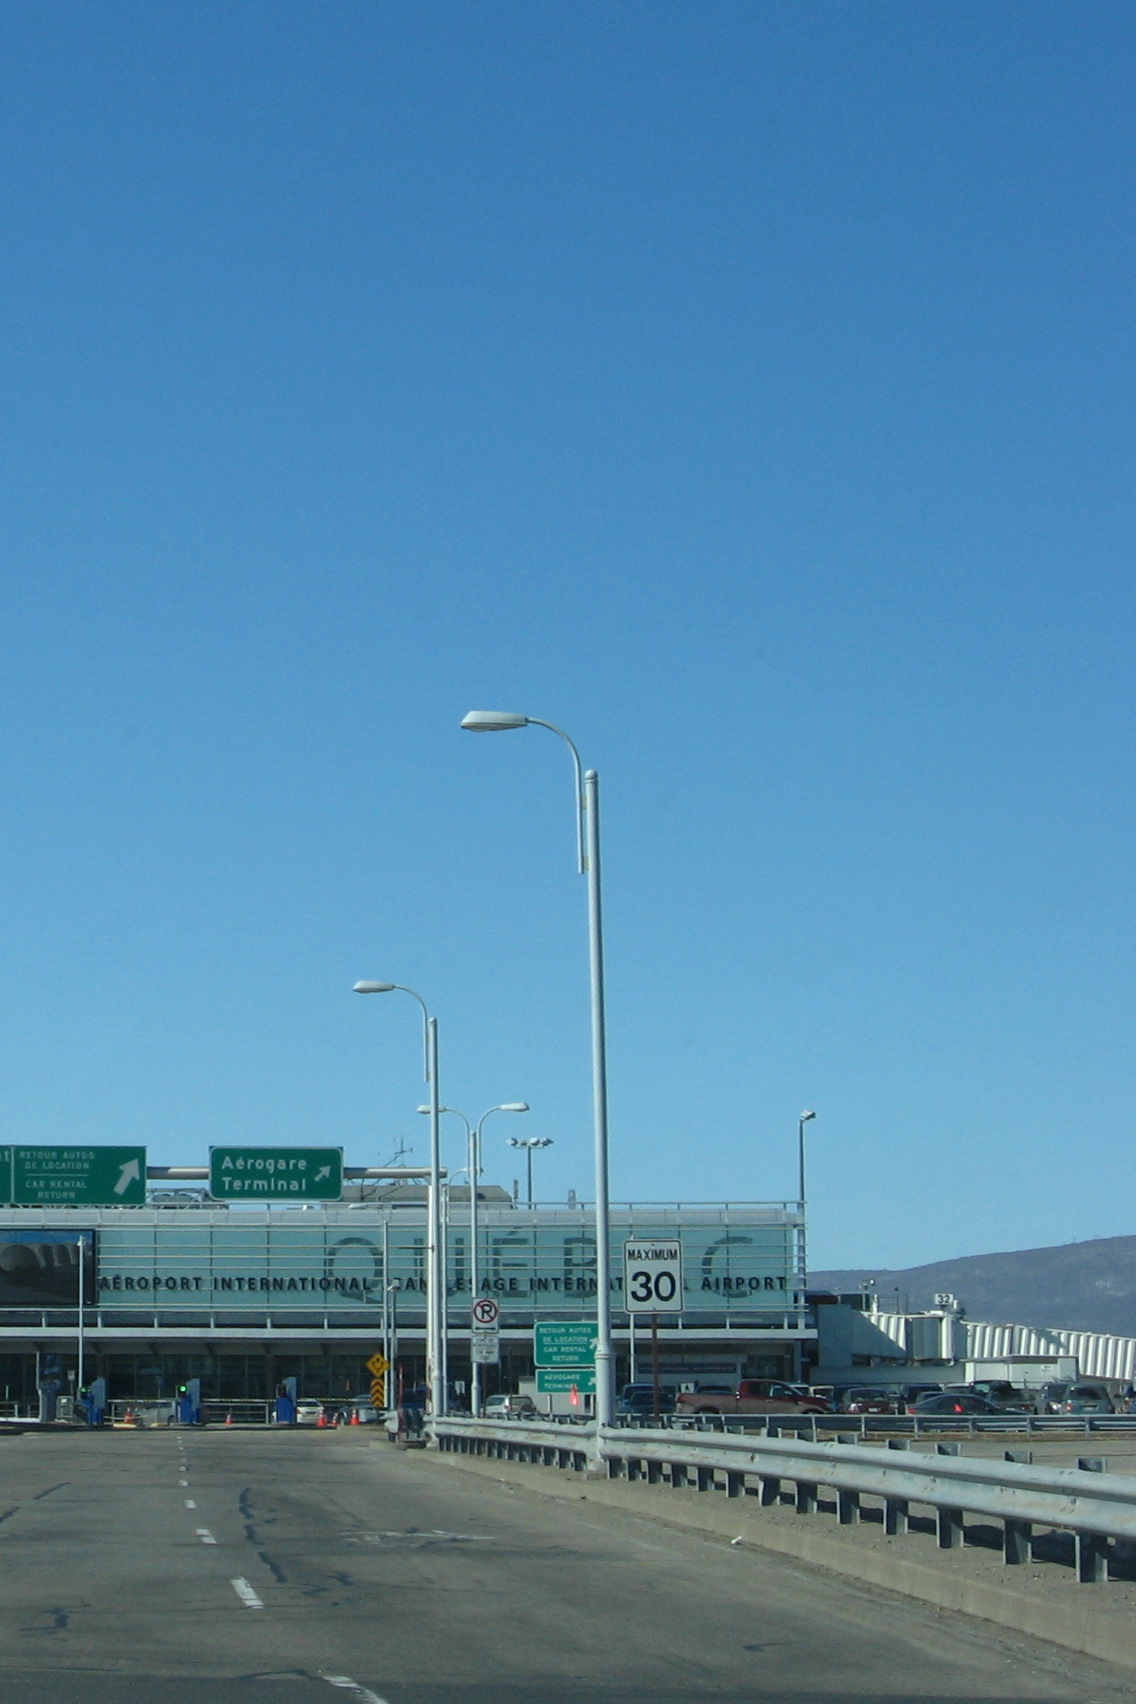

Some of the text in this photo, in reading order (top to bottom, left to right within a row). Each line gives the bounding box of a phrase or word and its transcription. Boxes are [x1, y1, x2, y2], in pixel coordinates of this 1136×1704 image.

[20, 1151, 95, 1159] RETOUR AUTOS
[25, 1162, 90, 1170] DE LOCATION
[221, 1156, 307, 1174] Aérogare
[221, 1177, 307, 1191] Terminal
[37, 1191, 76, 1199] RETURN
[628, 1249, 678, 1260] MAXIMUM
[99, 1274, 202, 1290] AÉROPORT
[214, 1276, 371, 1291] INTERNATIONAL
[701, 1276, 786, 1291] AIRPORT
[631, 1271, 676, 1302] 30
